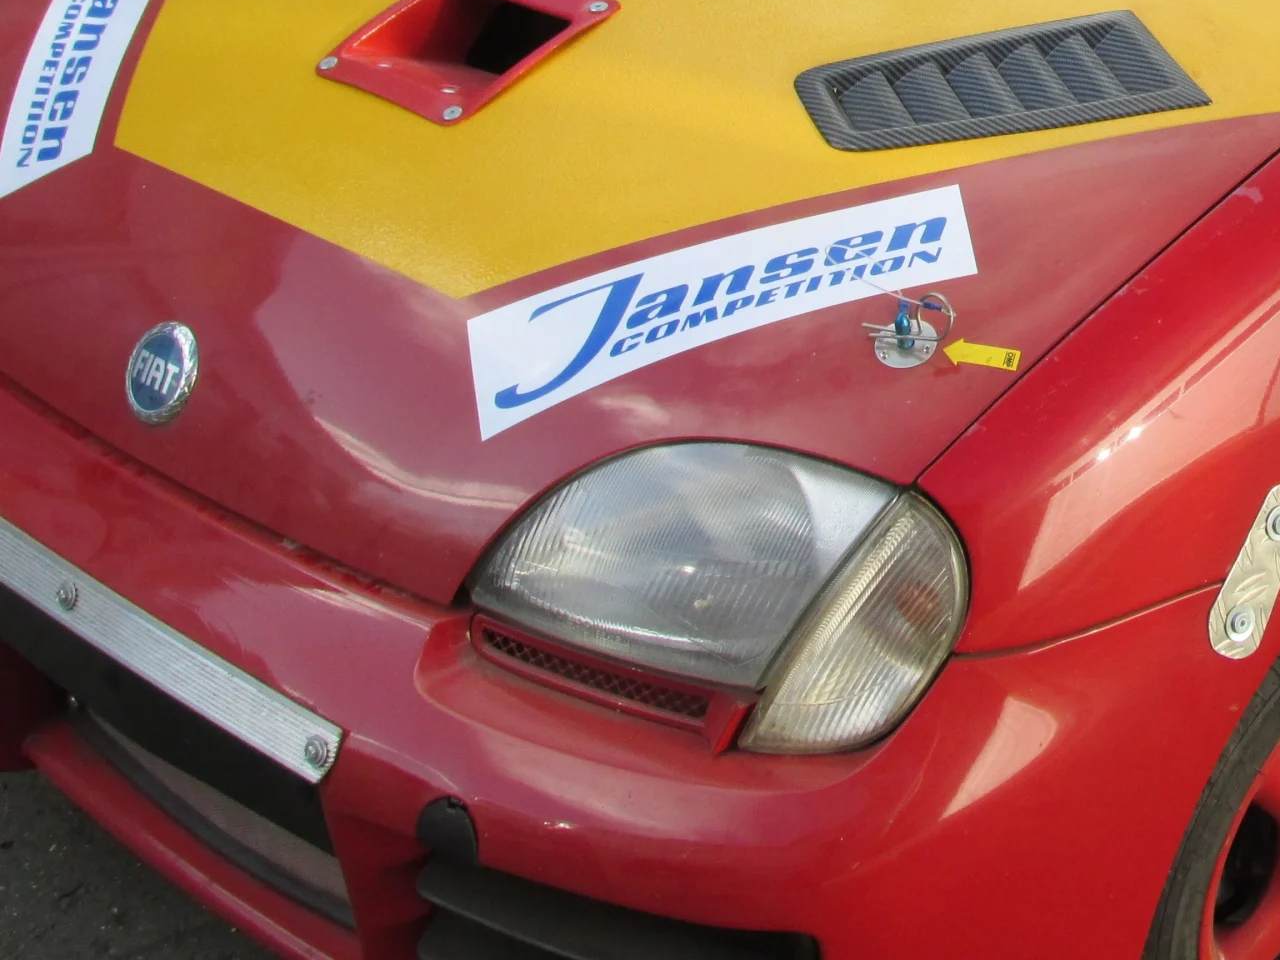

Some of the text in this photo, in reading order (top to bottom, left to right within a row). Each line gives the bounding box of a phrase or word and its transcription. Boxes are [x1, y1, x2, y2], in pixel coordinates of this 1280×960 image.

[494, 216, 947, 409] Jansen
[609, 246, 943, 358] COMPETITION
[132, 348, 180, 395] FIAT
